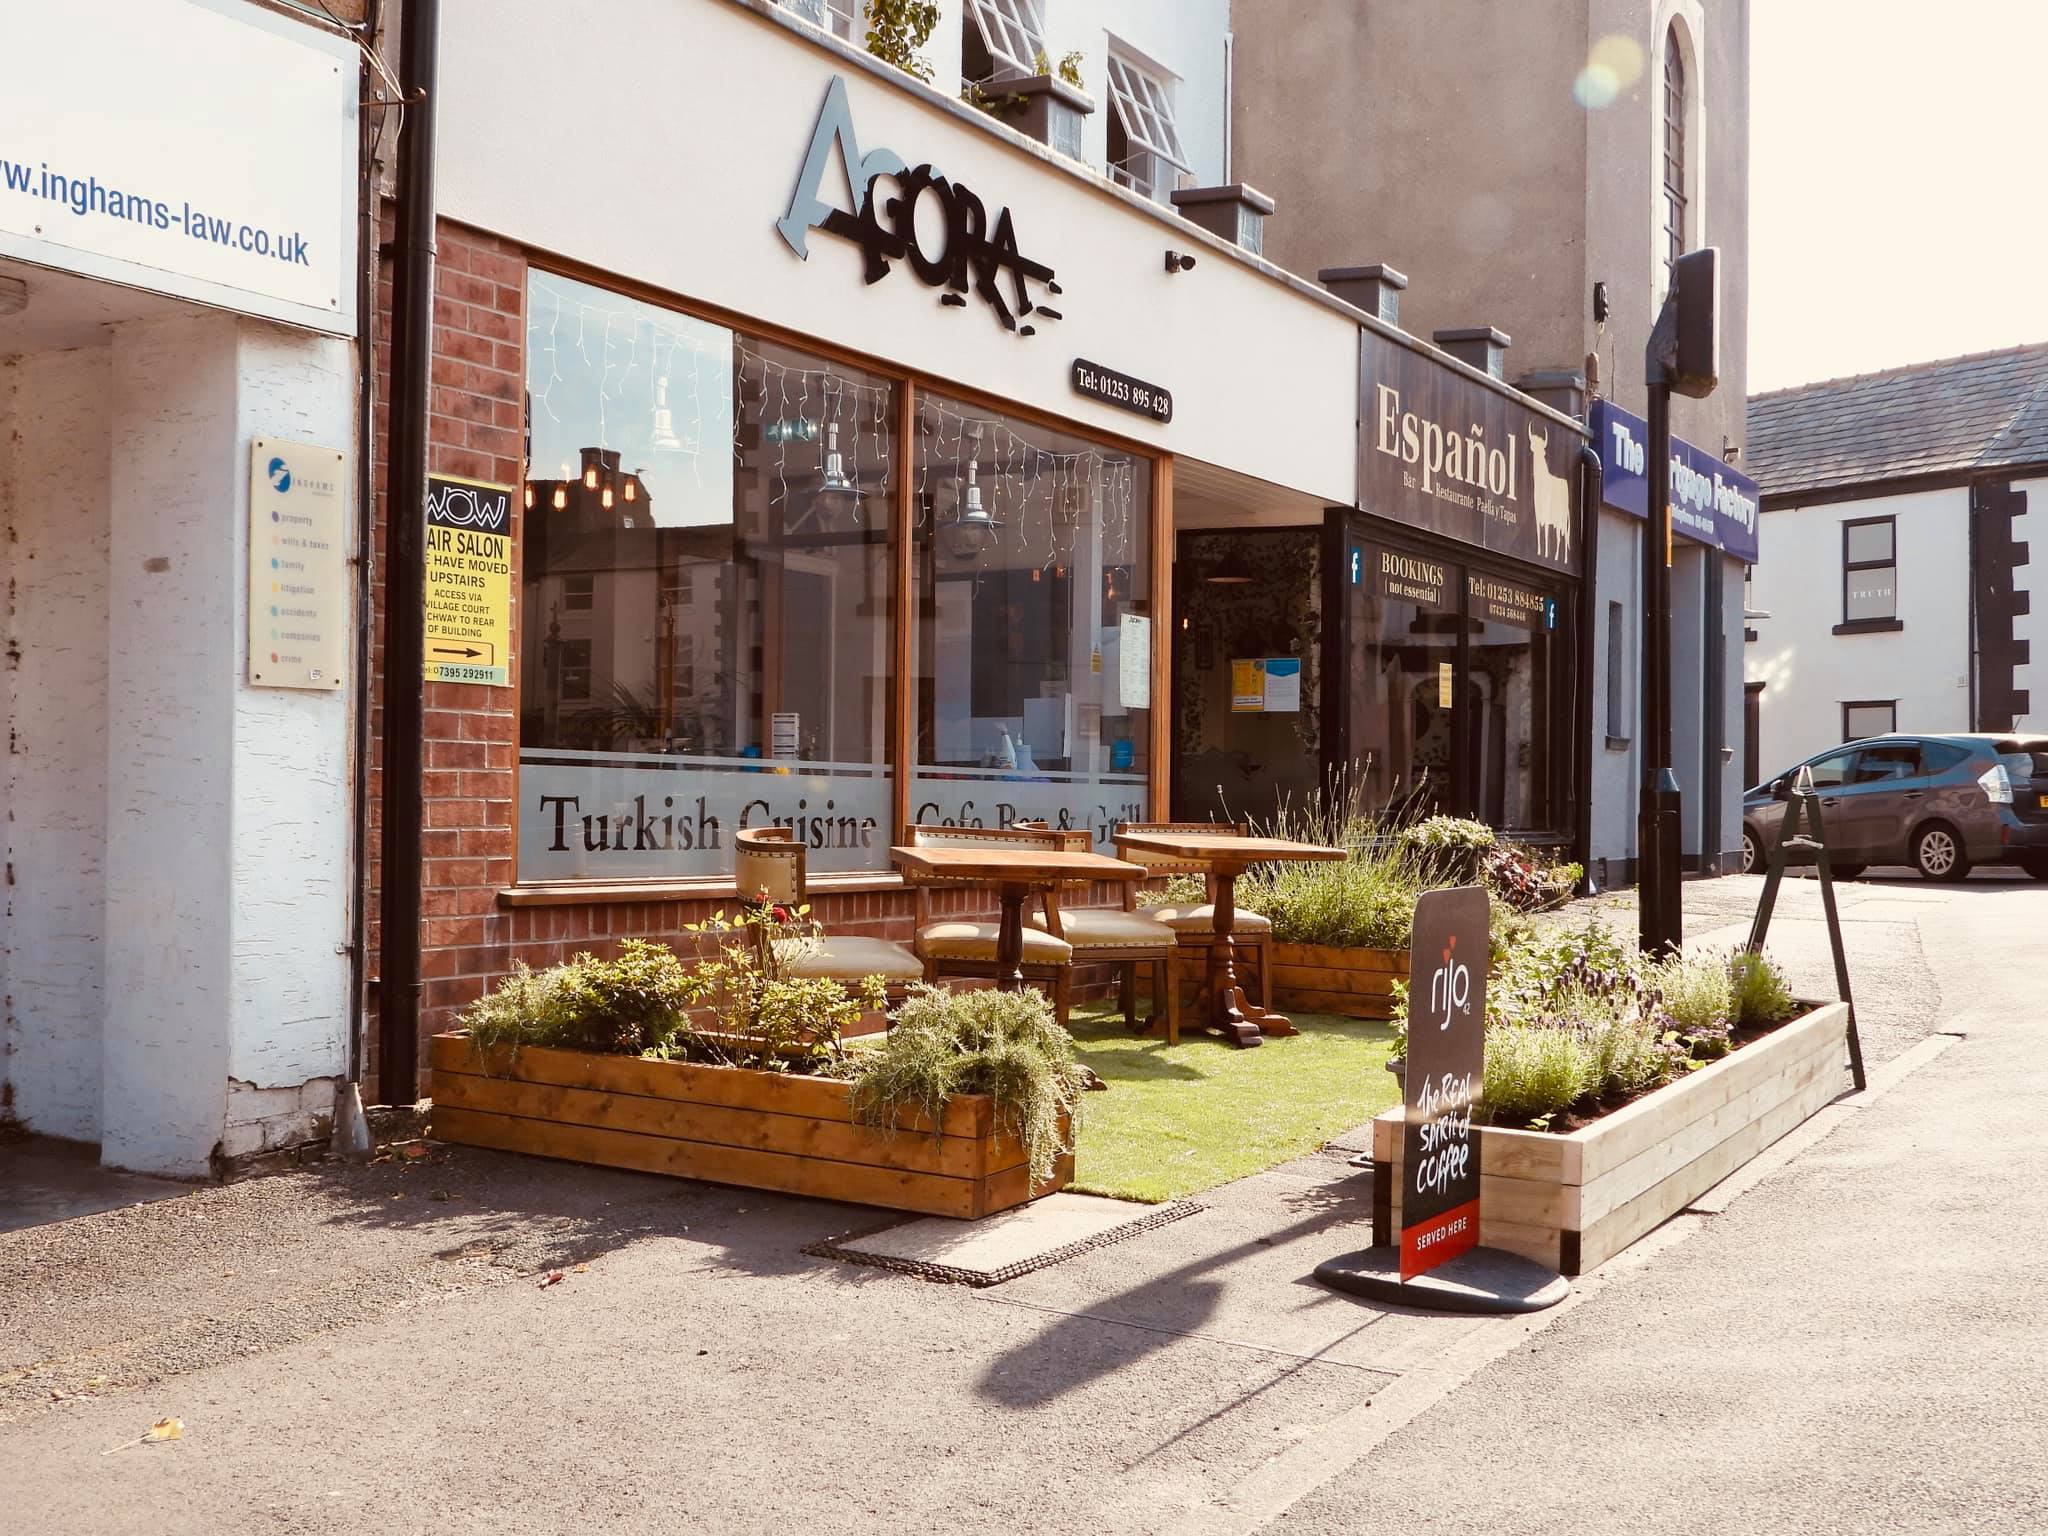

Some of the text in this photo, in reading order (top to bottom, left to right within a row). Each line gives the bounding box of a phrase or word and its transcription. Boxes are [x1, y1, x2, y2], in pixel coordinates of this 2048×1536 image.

[0, 159, 310, 266] w.inghams-law.co.uk
[776, 74, 1060, 333] AGORA
[1077, 367, 1169, 415] Tel: 01253 895 428
[1376, 383, 1517, 501] Español
[1612, 421, 1644, 476] The
[1669, 455, 1712, 511] rtgage
[428, 486, 506, 529] WOW
[1403, 471, 1417, 489] Bar
[1500, 505, 1518, 526] Tapas
[427, 527, 452, 553] AIR
[457, 532, 504, 560] SALON
[430, 571, 486, 589] UPSTAIRS
[434, 554, 465, 570] HAVE
[468, 558, 509, 575] MOVED
[1381, 552, 1444, 586] BOOKINGS
[425, 599, 491, 615] VILLAGE COURT
[434, 588, 483, 602] ACCESS VIA
[1468, 576, 1486, 598] Tel:
[1487, 583, 1513, 605] 01253
[426, 612, 495, 628] CHWAY TO REAR
[428, 624, 483, 638] OF BUILDING
[462, 668, 494, 681] 292911
[539, 795, 722, 852] Turkish
[1416, 1216, 1468, 1251] SERVED HERE
